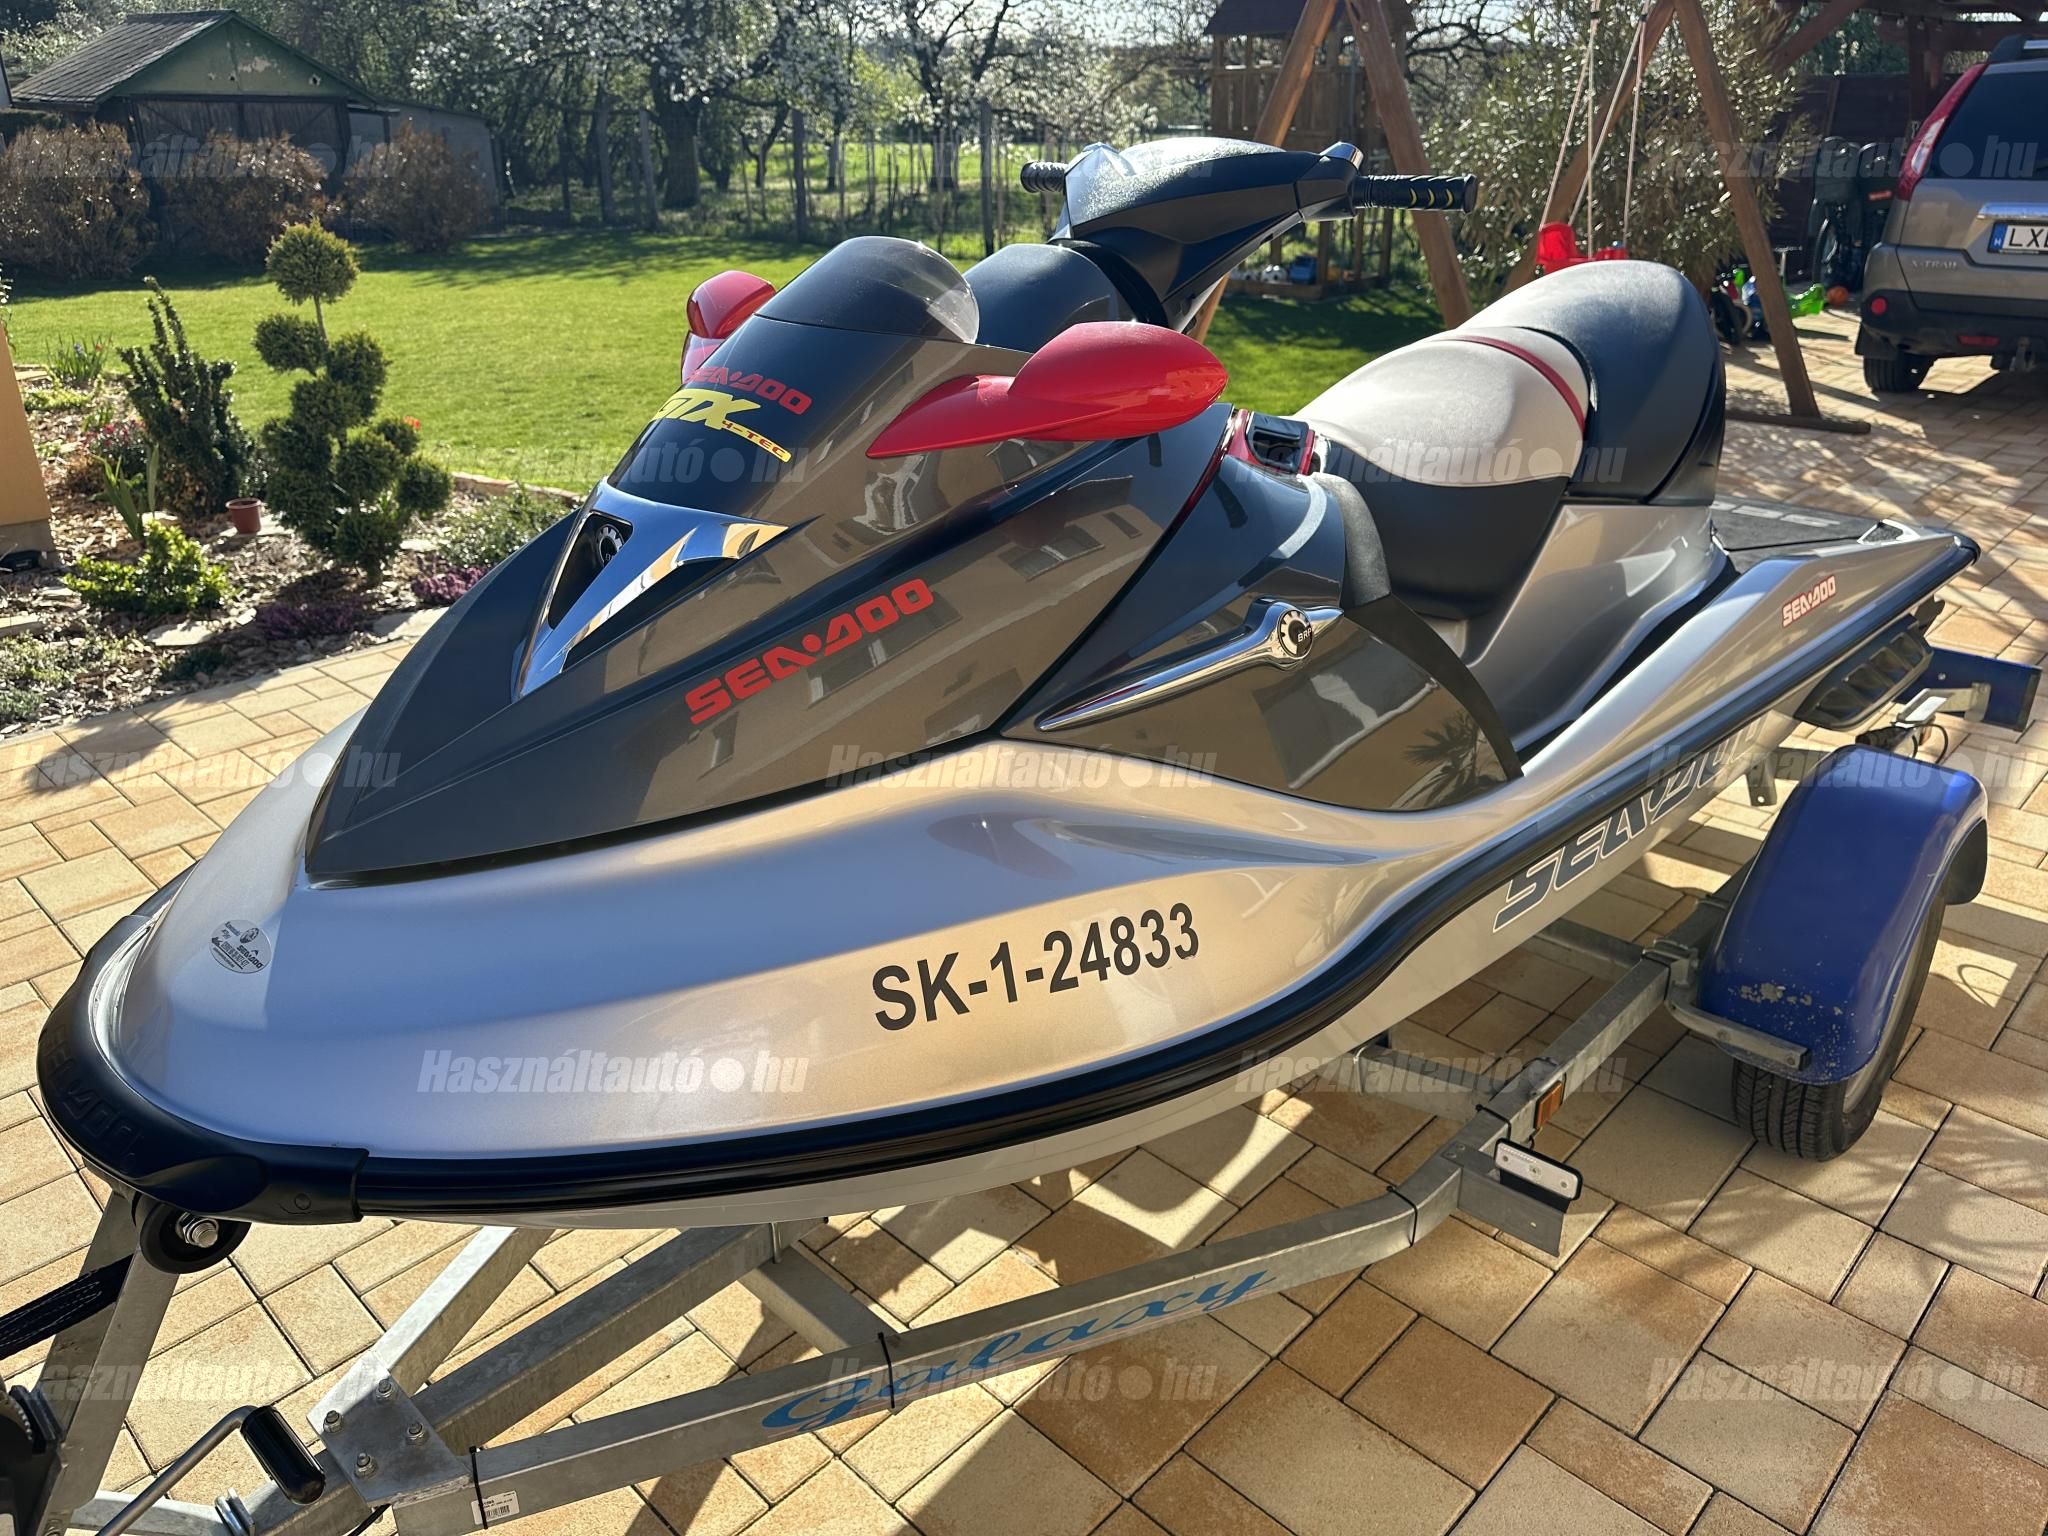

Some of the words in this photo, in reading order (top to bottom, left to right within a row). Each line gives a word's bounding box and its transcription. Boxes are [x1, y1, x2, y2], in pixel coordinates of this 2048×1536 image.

[2008, 227, 2048, 249] LX
[649, 388, 762, 431] GTX
[1297, 626, 1313, 643] BRP
[872, 902, 1200, 1031] SK-1-24833
